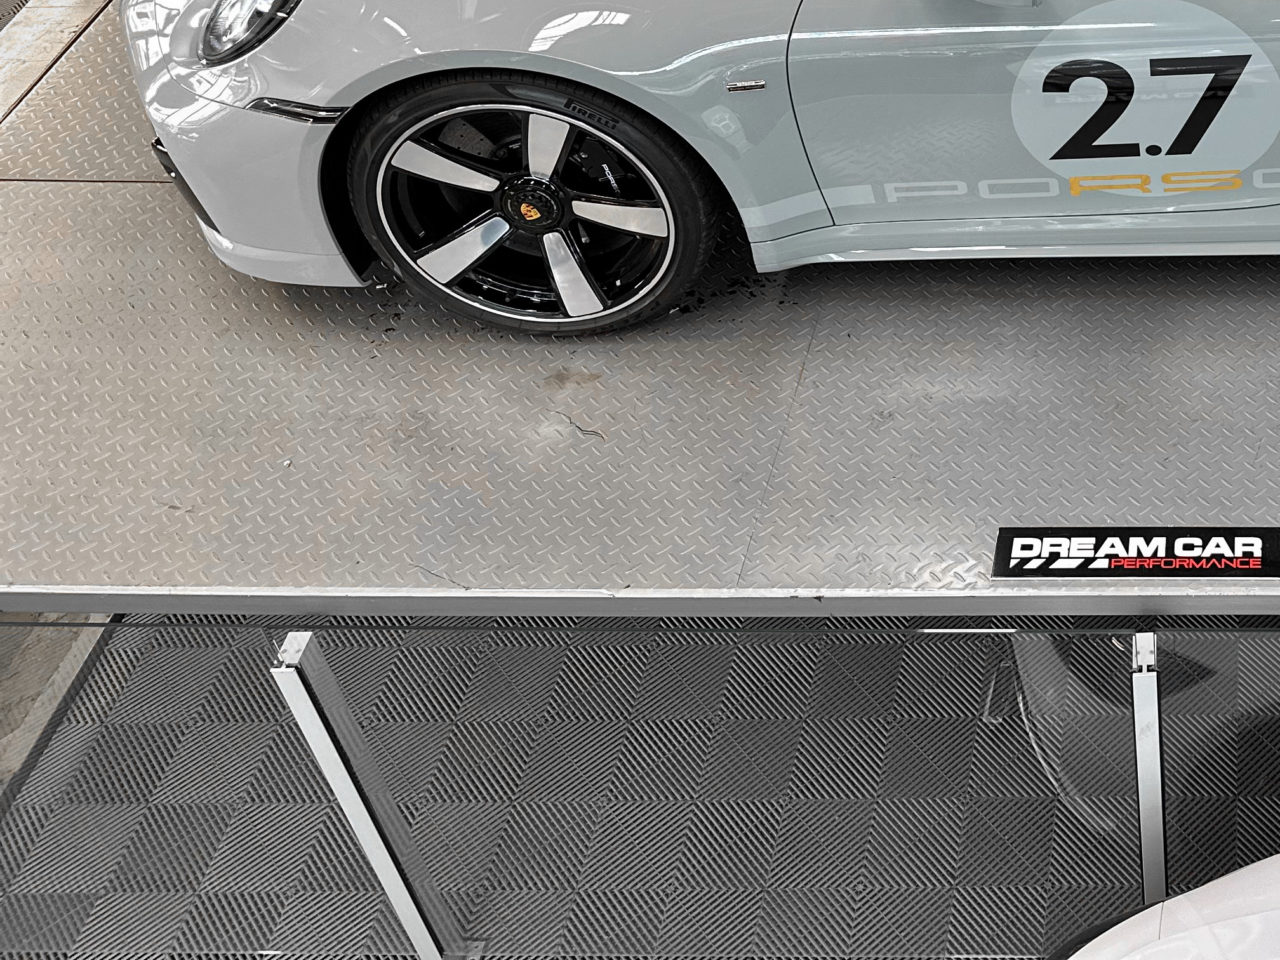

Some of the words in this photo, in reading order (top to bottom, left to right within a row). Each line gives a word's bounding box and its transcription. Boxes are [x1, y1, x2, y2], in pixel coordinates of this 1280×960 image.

[563, 97, 620, 130] PIRELLI
[1041, 53, 1253, 161] 2.7
[1010, 536, 1167, 558] DREAM
[1173, 536, 1263, 558] CAR
[1110, 558, 1262, 570] PERFORMANCE
